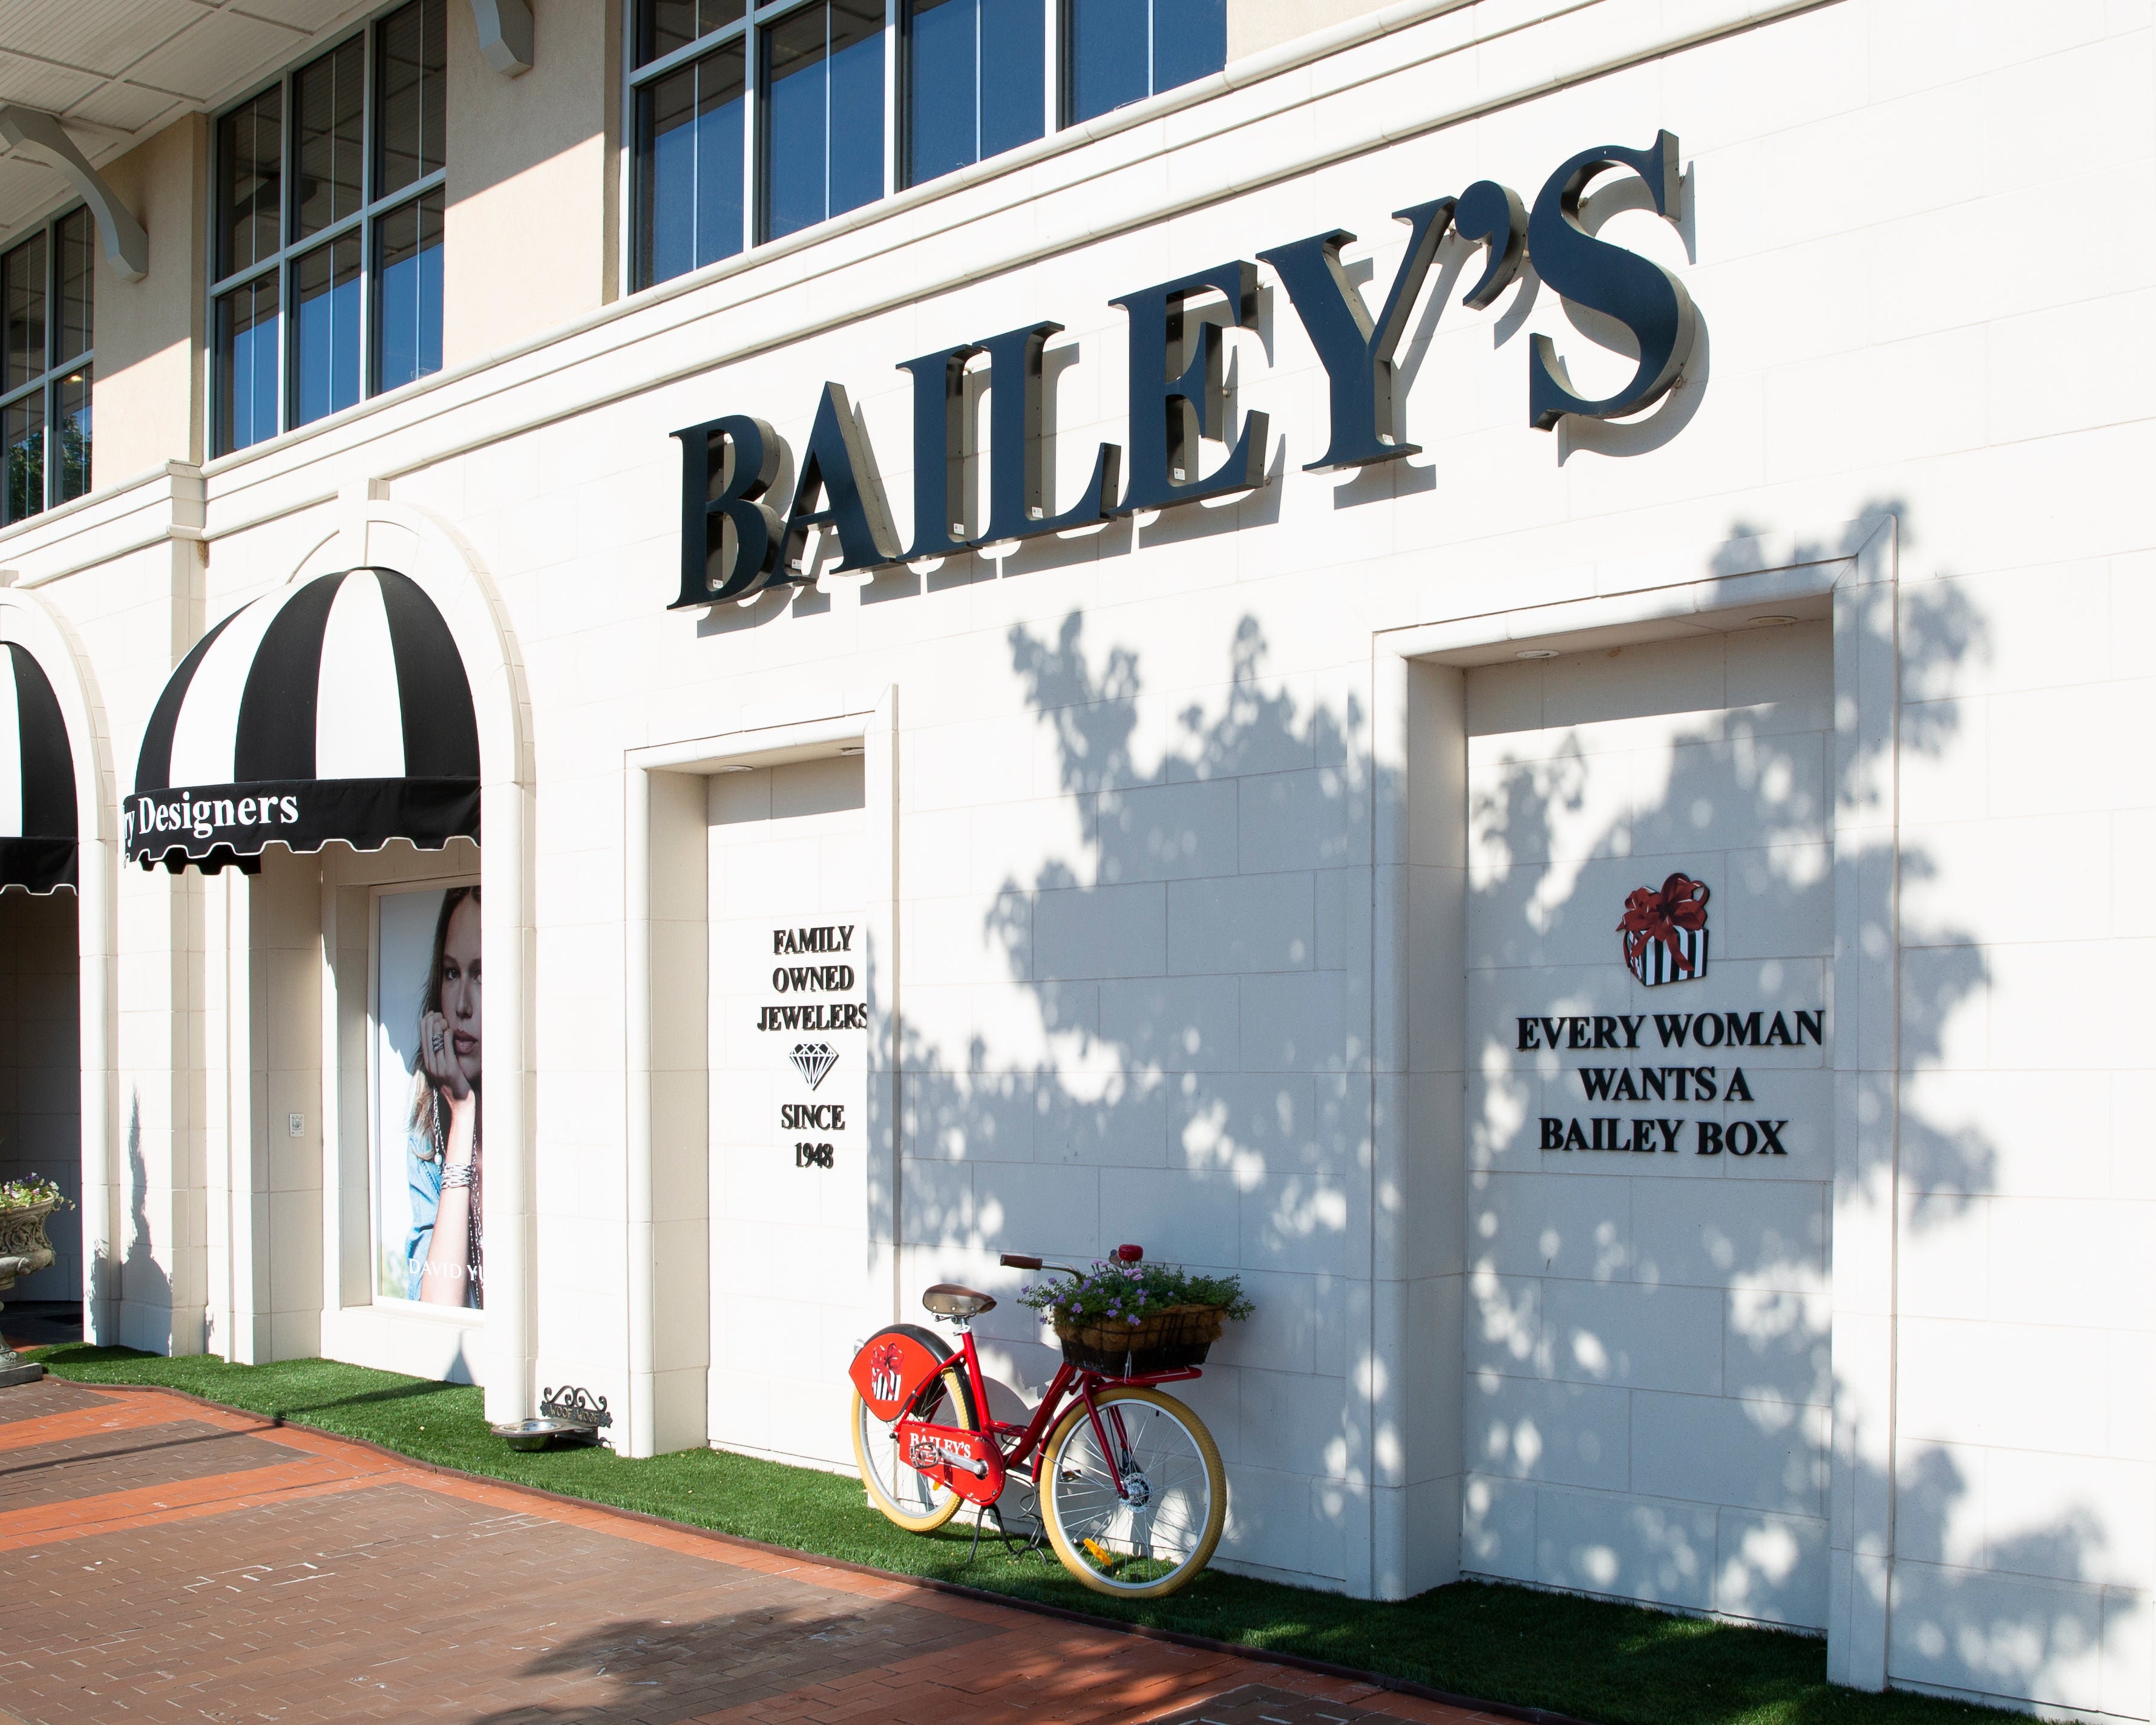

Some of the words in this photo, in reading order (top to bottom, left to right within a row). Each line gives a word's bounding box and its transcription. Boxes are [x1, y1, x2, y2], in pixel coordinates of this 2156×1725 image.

[667, 128, 1696, 610] BAILEY'S
[137, 790, 298, 838] Designers
[773, 925, 854, 954] FAMILY
[772, 965, 854, 993] OWNED
[757, 1003, 867, 1031] JEWELERS
[1515, 1014, 1646, 1052] EVERY
[1653, 1010, 1825, 1048] WOMAN
[1578, 1066, 1717, 1101] WANTS
[1723, 1067, 1754, 1102] A
[781, 1104, 845, 1130] SINCE
[1538, 1117, 1684, 1152] BAILEY
[1696, 1120, 1788, 1156] BOX
[794, 1142, 834, 1169] 1948
[408, 1258, 462, 1279] DAVID
[549, 1404, 573, 1418] WOOF
[576, 1409, 600, 1423] WOOF
